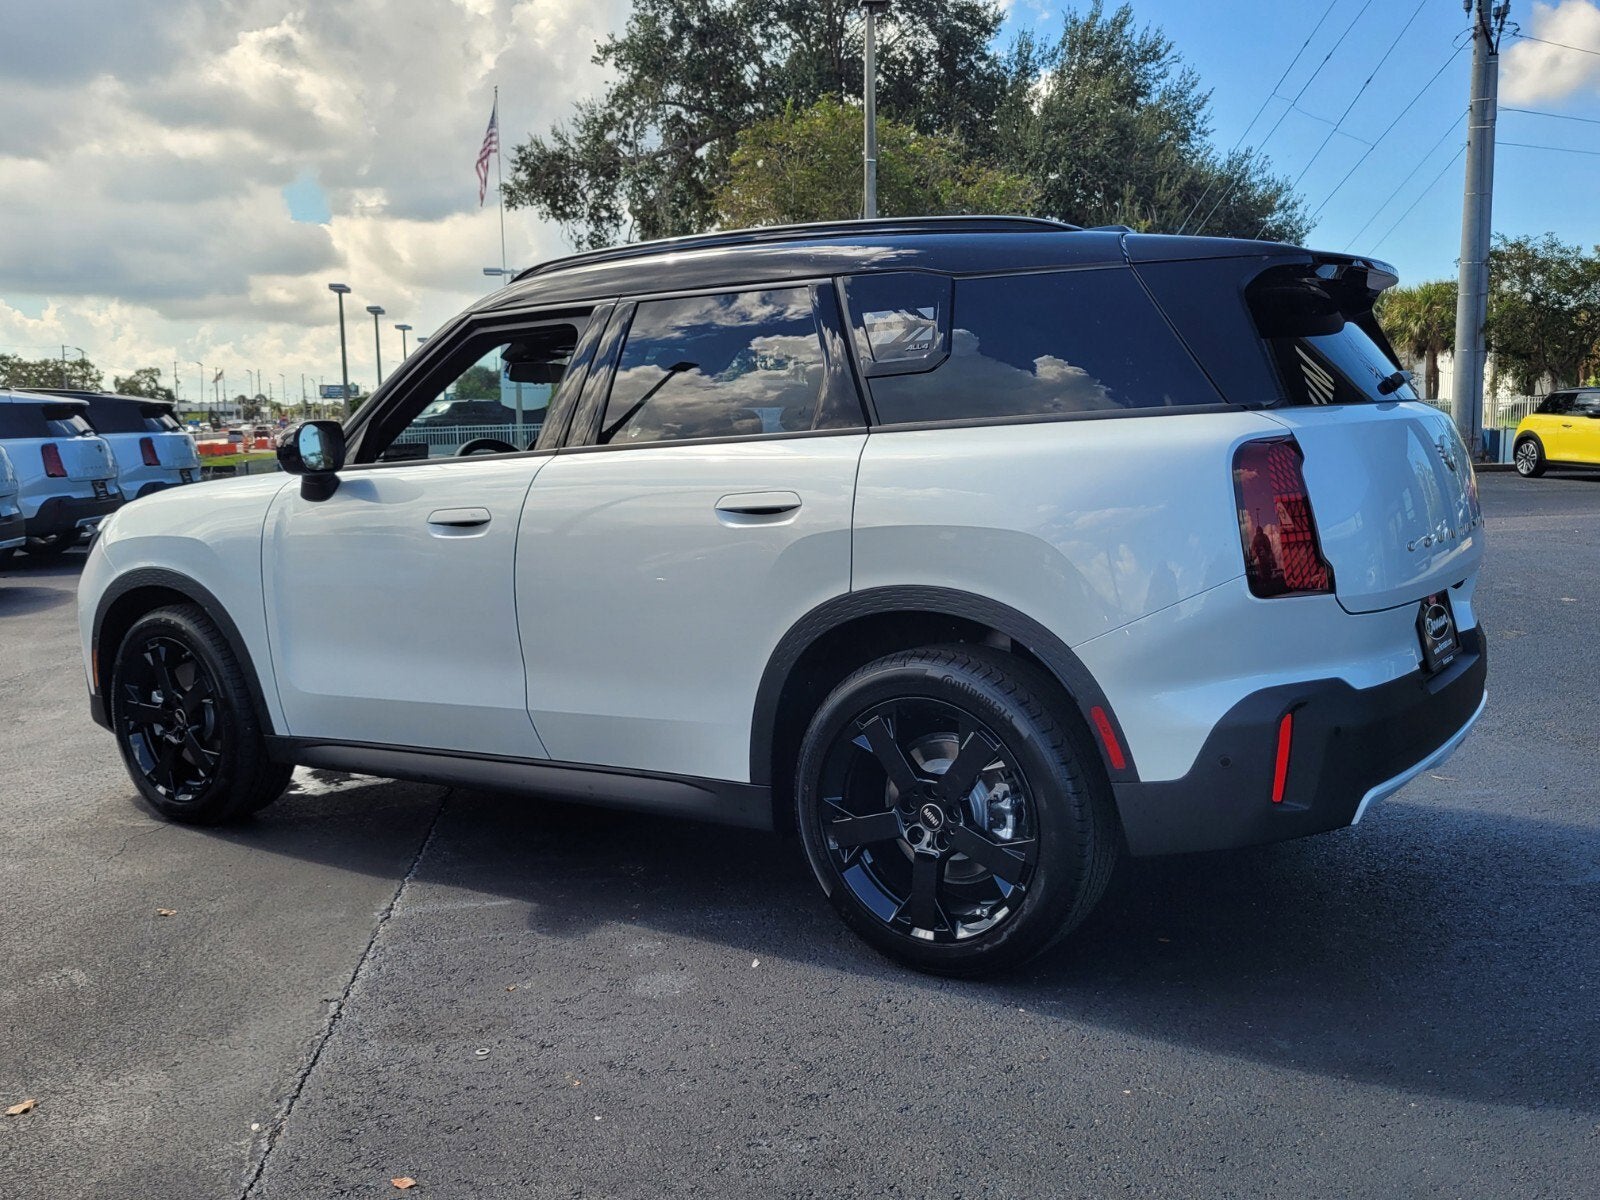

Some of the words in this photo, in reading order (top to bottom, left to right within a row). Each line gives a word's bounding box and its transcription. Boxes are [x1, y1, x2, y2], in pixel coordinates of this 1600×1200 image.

[905, 343, 930, 351] ALL4
[941, 674, 1008, 718] Continental
[923, 808, 939, 826] MINI
